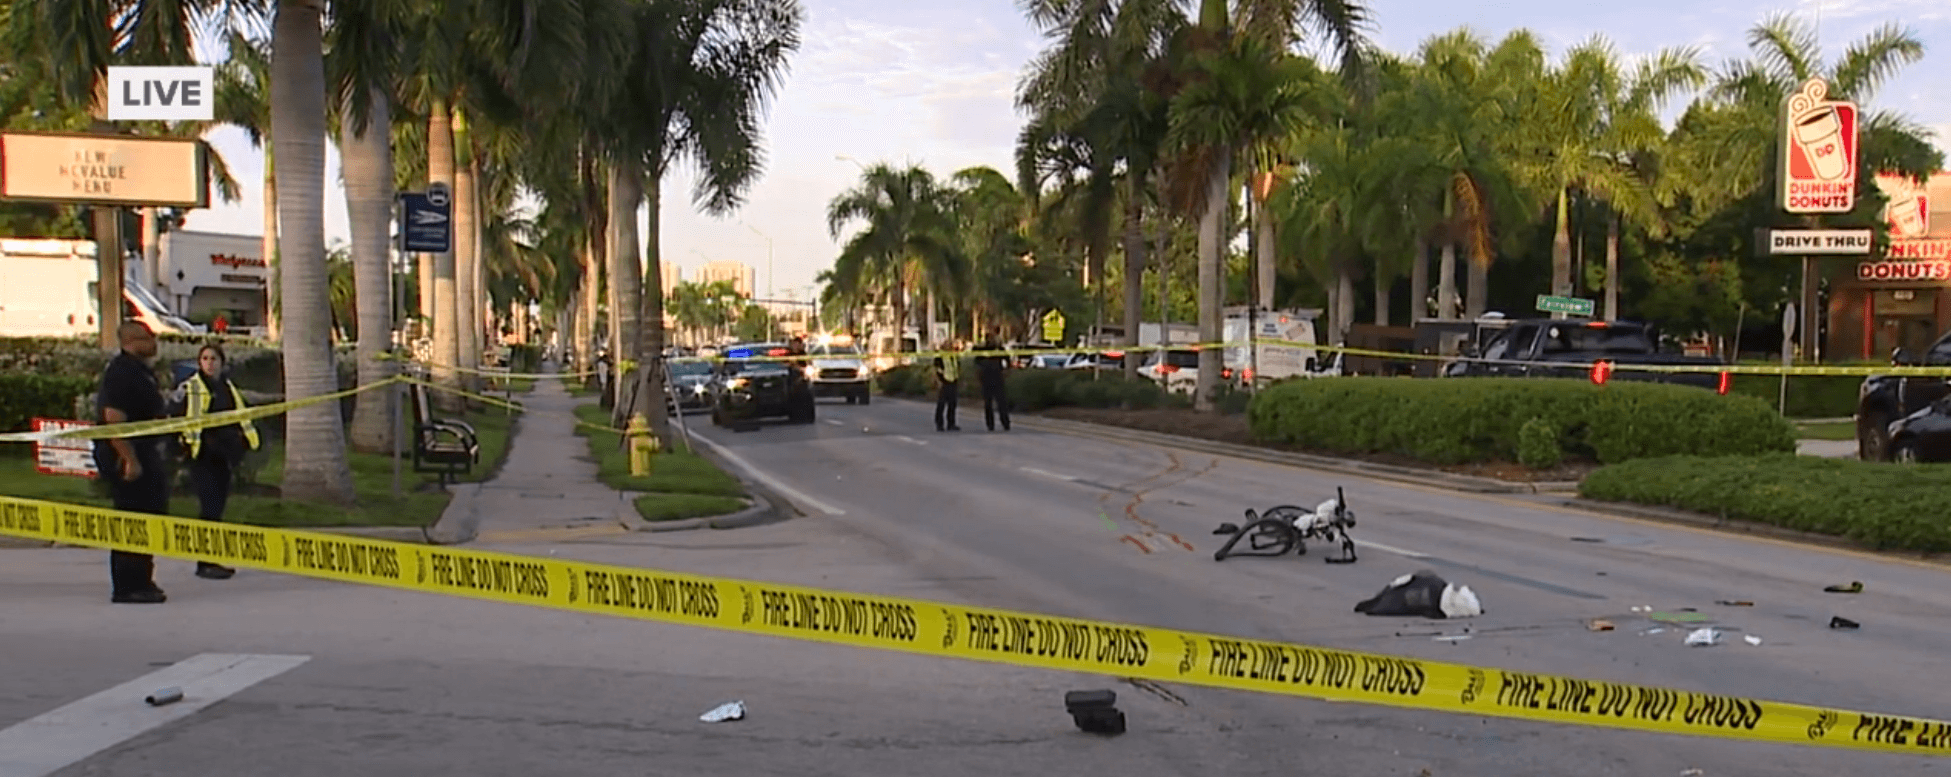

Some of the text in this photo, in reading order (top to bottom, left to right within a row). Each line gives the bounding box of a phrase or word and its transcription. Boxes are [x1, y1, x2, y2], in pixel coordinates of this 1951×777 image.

[1789, 196, 1848, 208] DONUTS
[1774, 236, 1868, 248] DRIVE THRU
[1860, 263, 1946, 278] DONUTS
[296, 537, 315, 568] FIRE
[315, 540, 335, 570] LINE
[336, 542, 349, 573] DO
[350, 544, 367, 575] NOT
[368, 545, 400, 578] CROSS
[432, 553, 453, 585] FIRE
[453, 555, 476, 588] LINE
[476, 558, 491, 590] DO
[491, 560, 512, 593] NOT
[514, 562, 548, 598] CROSS
[585, 570, 610, 605] FIRE
[610, 573, 636, 608] LINE
[636, 576, 654, 611] DO
[653, 578, 677, 614] NOT
[679, 580, 719, 618] CROSS
[761, 590, 789, 627] FIRE
[790, 592, 819, 631] LINE
[820, 596, 841, 633] DO
[840, 598, 868, 635] NOT
[870, 601, 916, 641] CROSS
[966, 612, 999, 650] FIRE
[999, 614, 1034, 654] LINE
[1035, 619, 1060, 657] DO
[1059, 622, 1091, 661] NOT
[1094, 626, 1149, 666] CROSS
[1208, 639, 1247, 677] FIRE
[1247, 642, 1289, 682] LINE
[1292, 647, 1319, 685] DO
[1319, 650, 1356, 689] NOT
[1361, 656, 1425, 695] CROSS
[1497, 671, 1544, 708] FIRE
[1547, 677, 1596, 714] LINE
[1598, 681, 1633, 717] DO
[1633, 686, 1678, 722] NOT
[1684, 692, 1763, 730] CROSS
[1853, 714, 1914, 745] FIRE
[1917, 722, 1951, 748] LI
